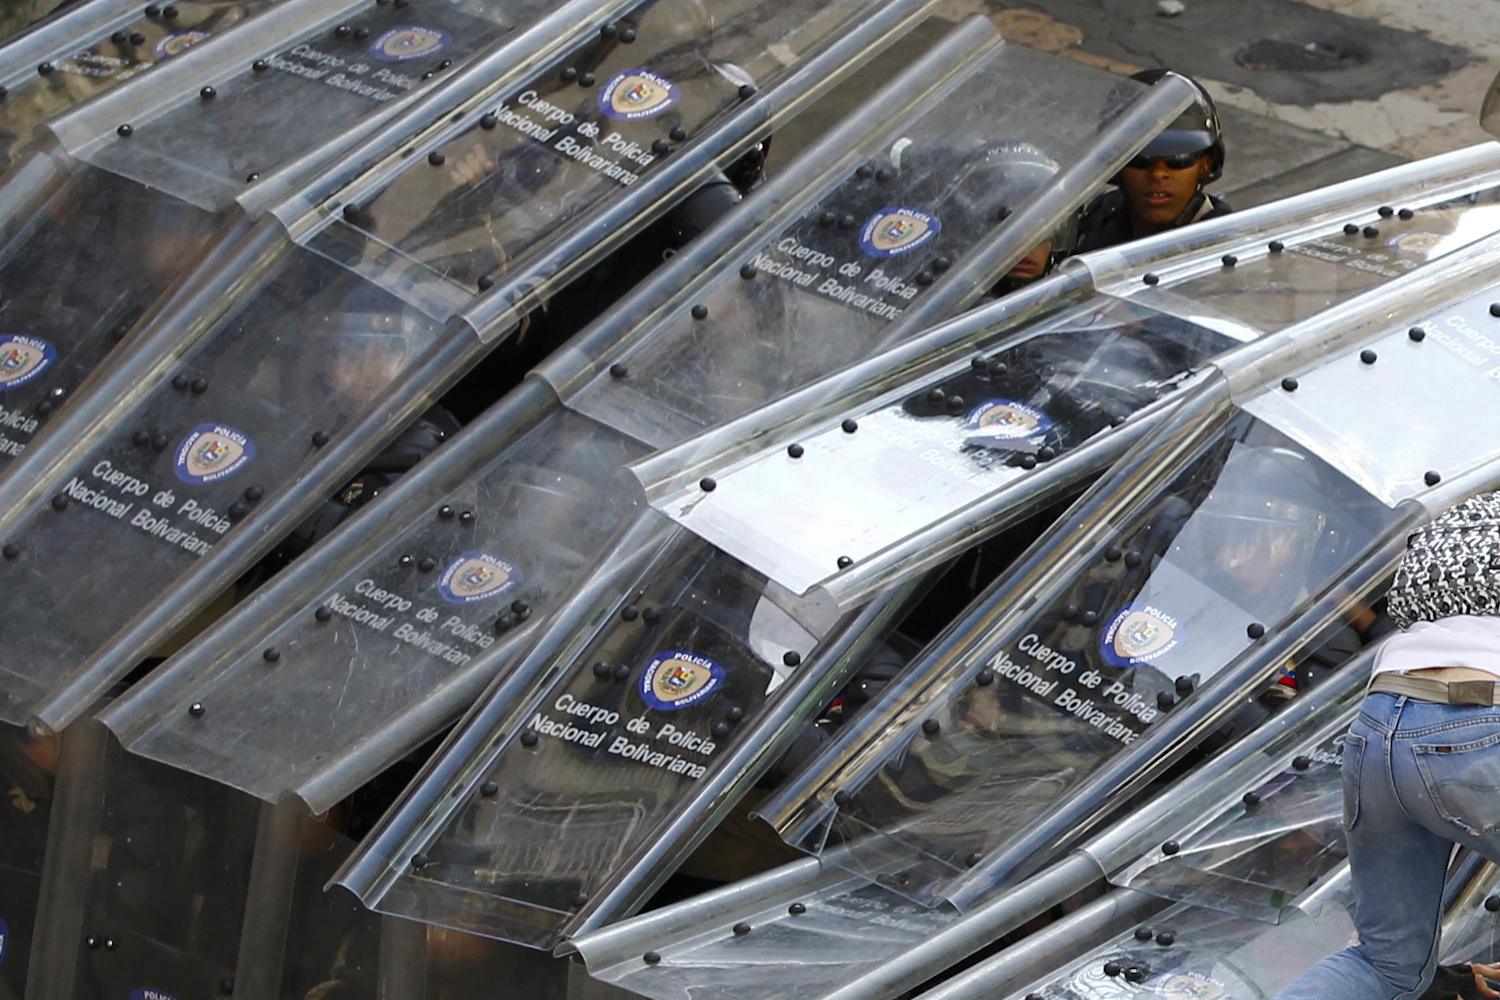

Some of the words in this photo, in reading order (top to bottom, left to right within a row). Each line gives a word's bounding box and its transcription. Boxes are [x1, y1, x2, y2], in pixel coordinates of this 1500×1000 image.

[518, 90, 574, 124] Cuerpo
[577, 121, 600, 138] de
[492, 103, 558, 143] Nacional
[554, 136, 639, 185] Bolivariana
[749, 253, 818, 287] Nacional
[778, 237, 834, 267] Cuerpo
[839, 261, 860, 277] de
[62, 477, 132, 520] Nacional
[93, 460, 149, 497] Cuerpo
[153, 489, 175, 508] de
[355, 579, 412, 612] Cuerpo
[416, 606, 438, 623] de
[323, 592, 394, 631] Nacional
[393, 623, 471, 665] Bolivarian
[987, 651, 1058, 697] Nacional
[1018, 634, 1076, 674] Cuerpo
[1078, 669, 1102, 689] de
[555, 694, 619, 725] Cuerpo
[626, 716, 650, 734] de
[527, 712, 607, 748] Nacional
[608, 735, 707, 780] Bolivariana
